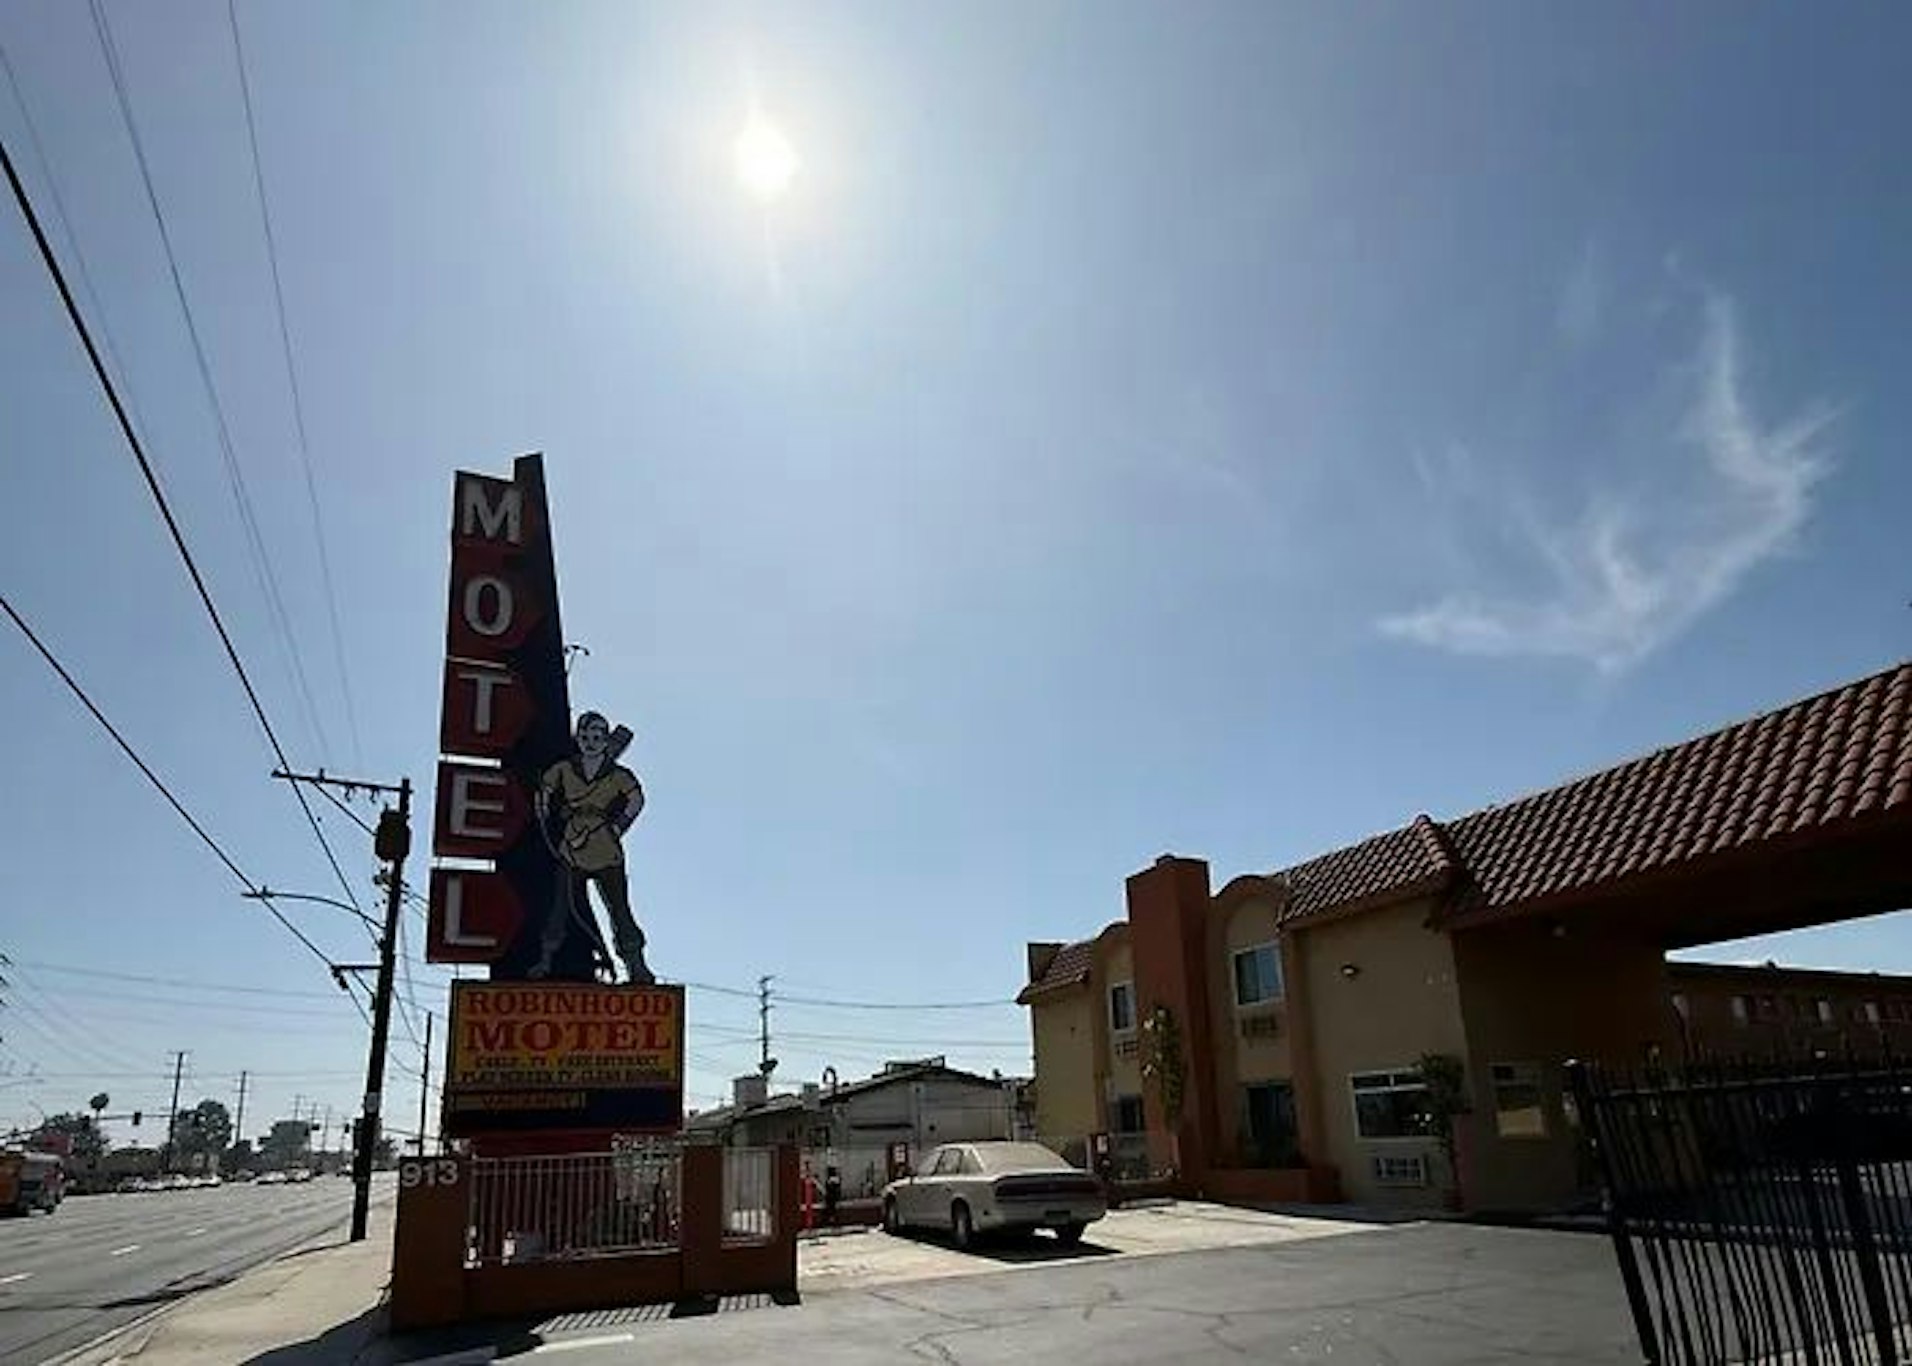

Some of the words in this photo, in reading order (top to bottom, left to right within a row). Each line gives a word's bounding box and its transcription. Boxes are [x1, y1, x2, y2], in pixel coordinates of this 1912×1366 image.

[444, 480, 523, 946] MOTEL
[466, 991, 672, 1016] ROBINHOOD
[463, 1020, 671, 1051] MOTEL
[401, 1160, 459, 1188] 913
